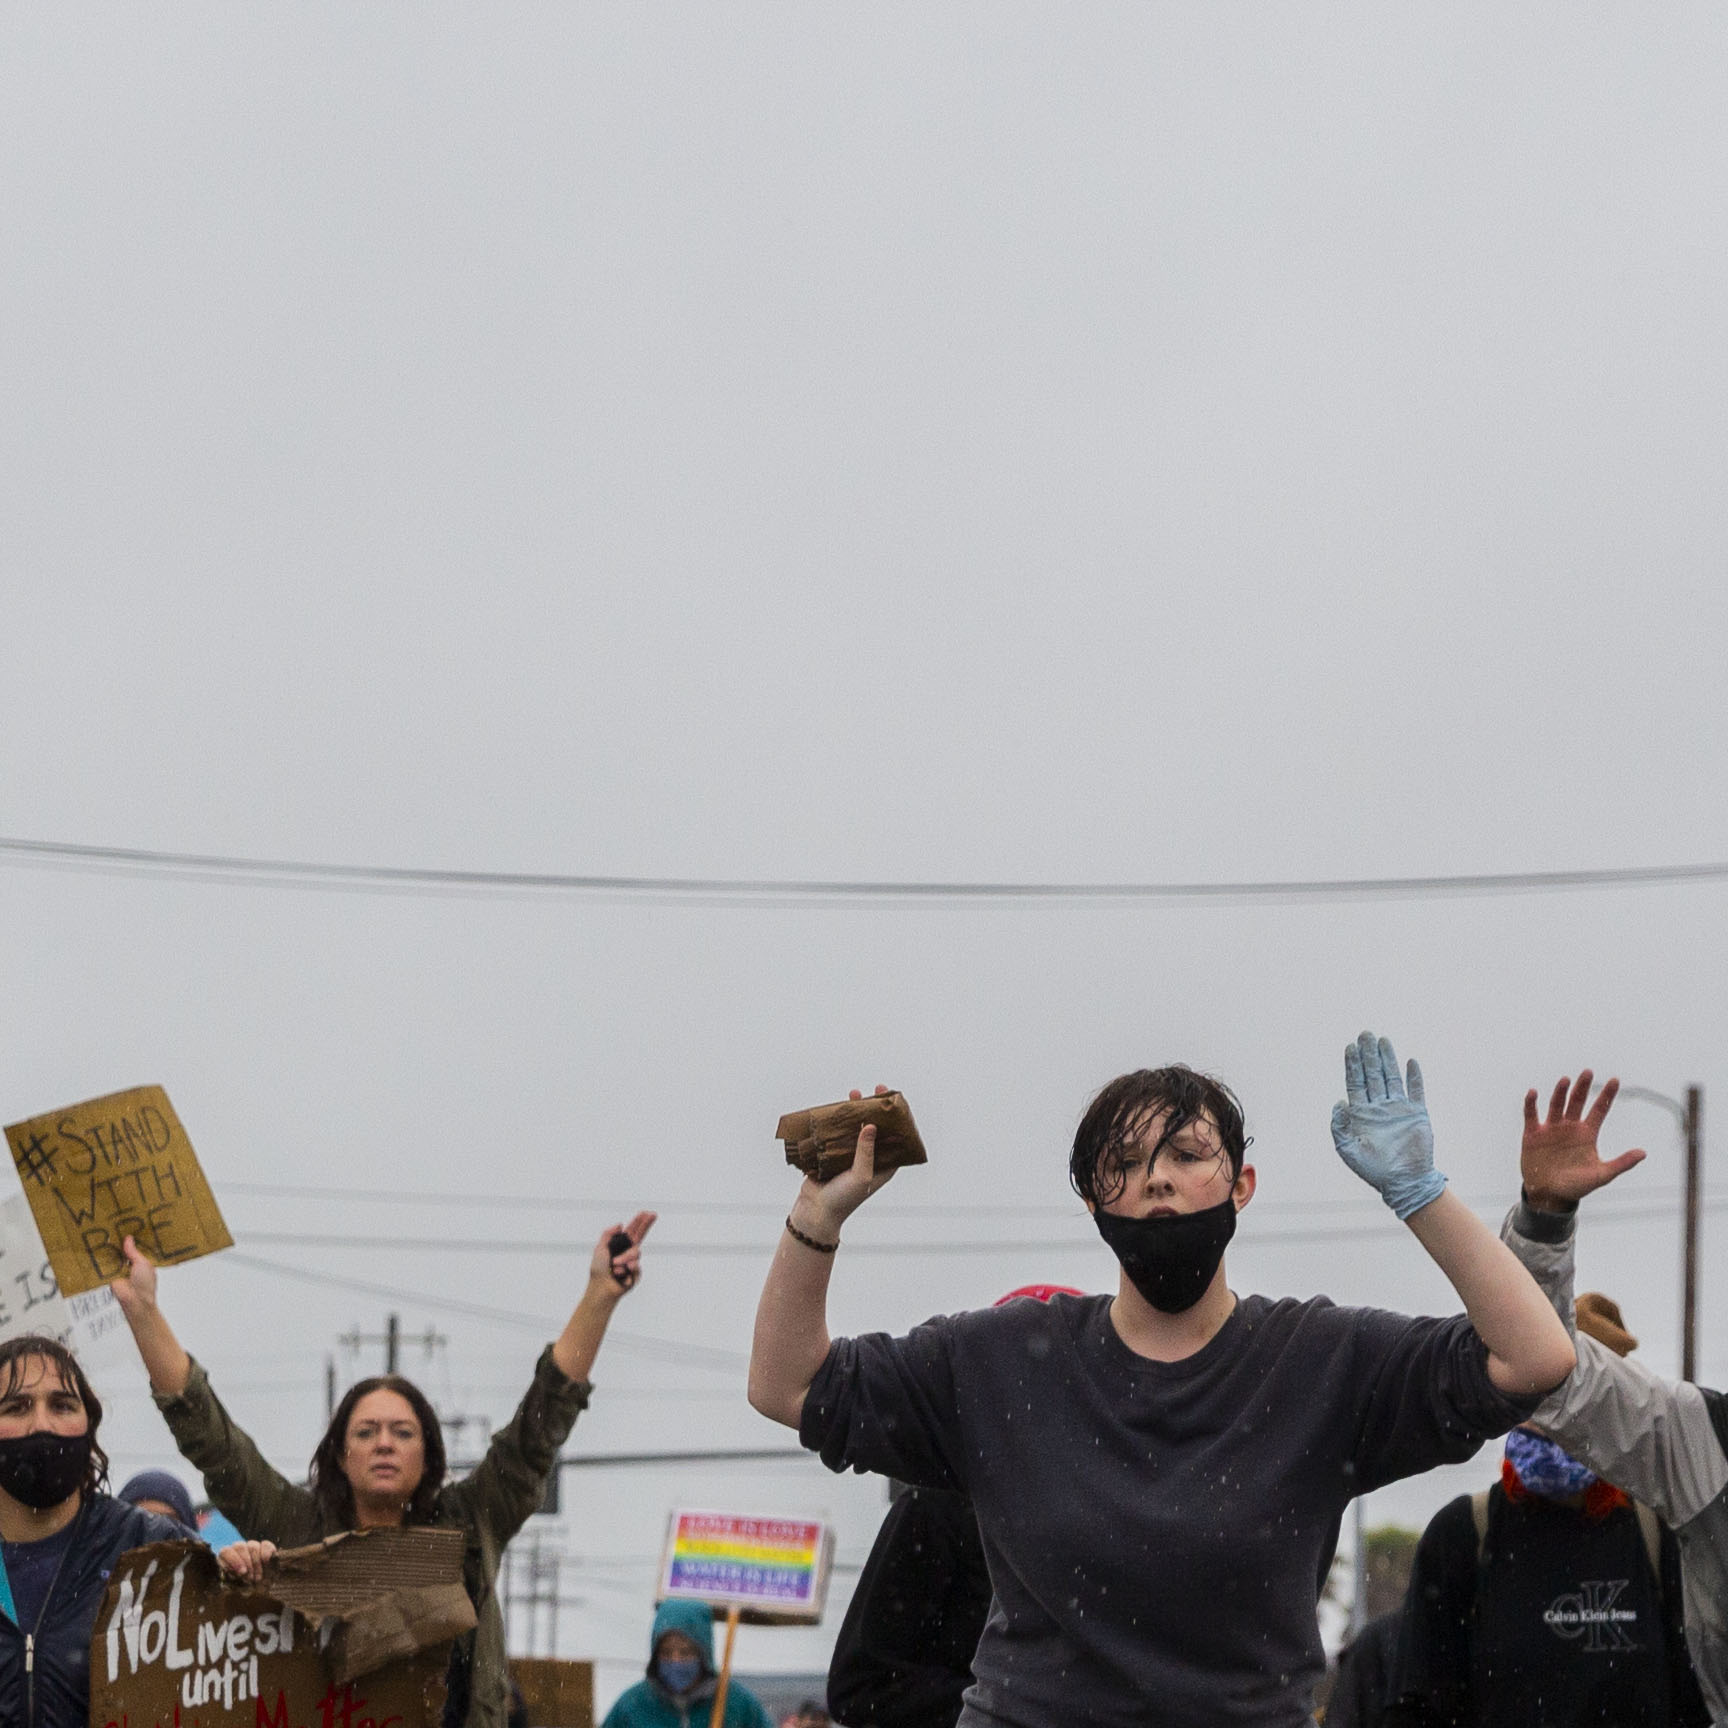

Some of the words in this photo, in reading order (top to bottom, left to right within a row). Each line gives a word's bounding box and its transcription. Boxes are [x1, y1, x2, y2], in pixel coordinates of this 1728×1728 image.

[52, 1161, 183, 1227] WITH
[14, 1262, 59, 1313] IS
[106, 1558, 166, 1684] No
[1543, 1608, 1579, 1624] Calvin
[1580, 1607, 1609, 1623] Klein
[181, 1654, 261, 1711] until
